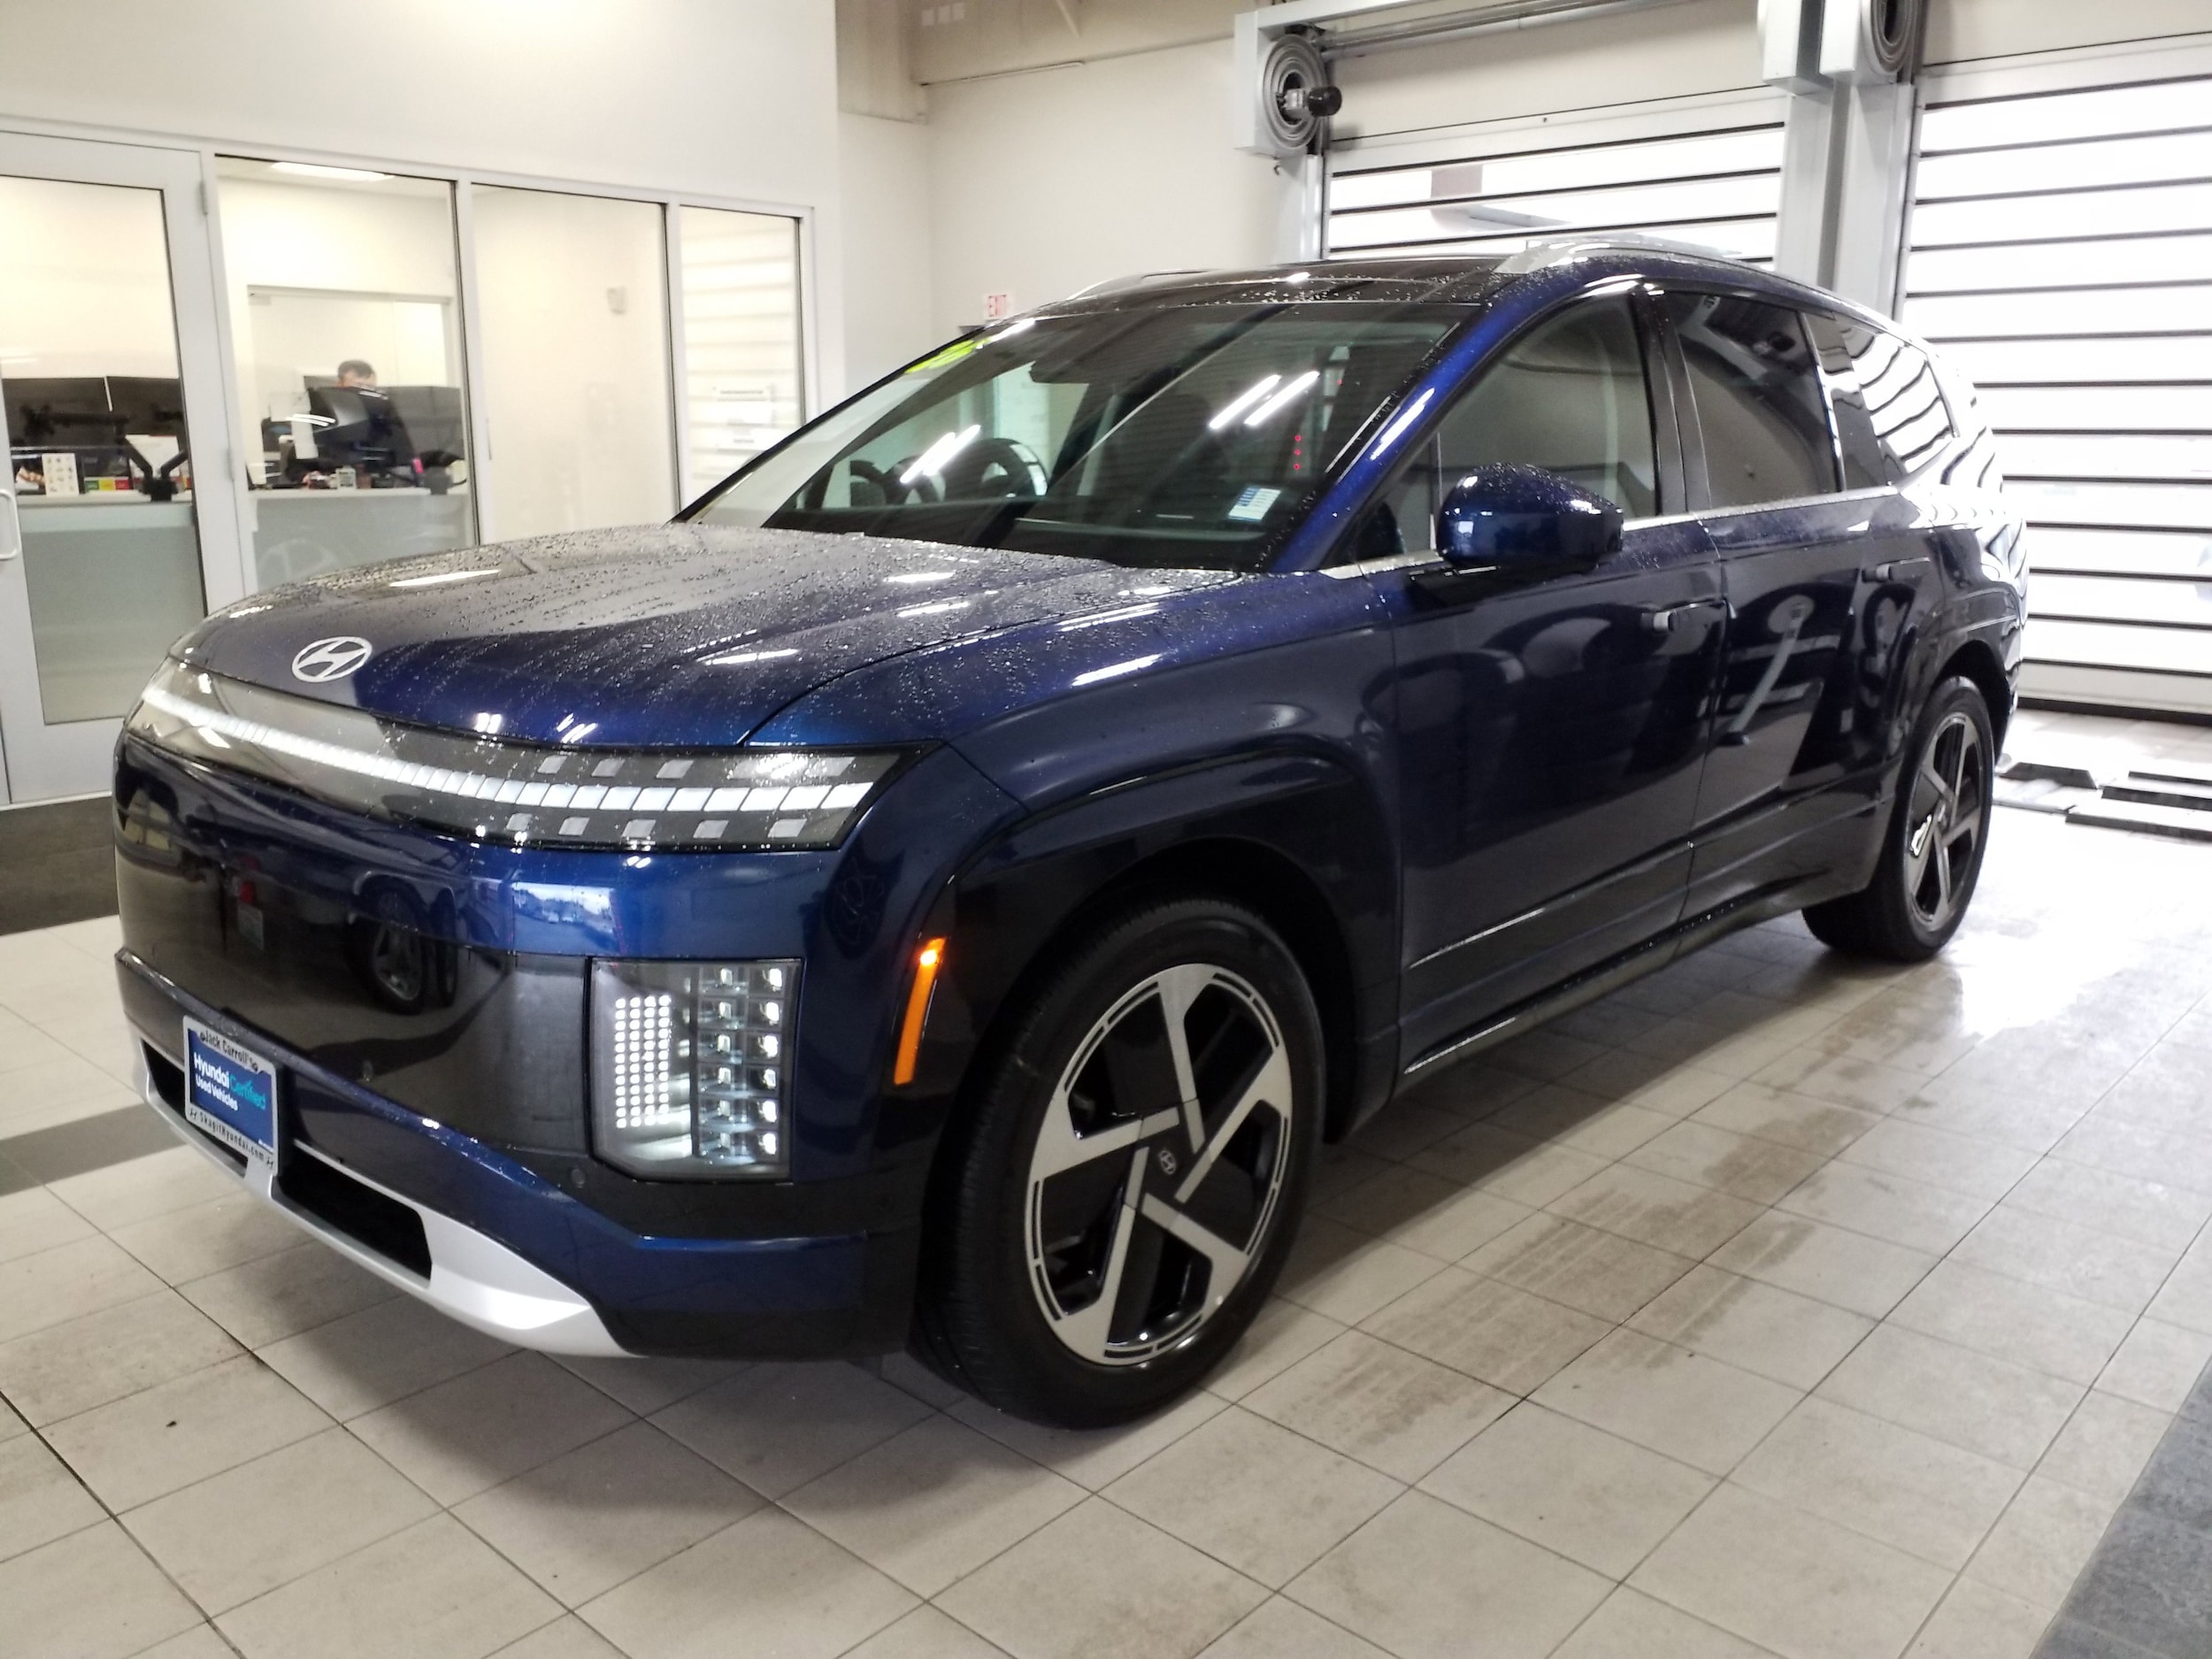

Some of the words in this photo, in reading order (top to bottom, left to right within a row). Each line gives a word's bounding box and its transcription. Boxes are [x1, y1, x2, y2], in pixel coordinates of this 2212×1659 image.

[204, 1030, 221, 1049] Jack
[222, 1041, 254, 1067] Carroll's
[194, 1052, 229, 1089] Hyundai
[230, 1075, 266, 1110] Certified
[195, 1075, 211, 1095] Used
[211, 1082, 239, 1111] Vehicles
